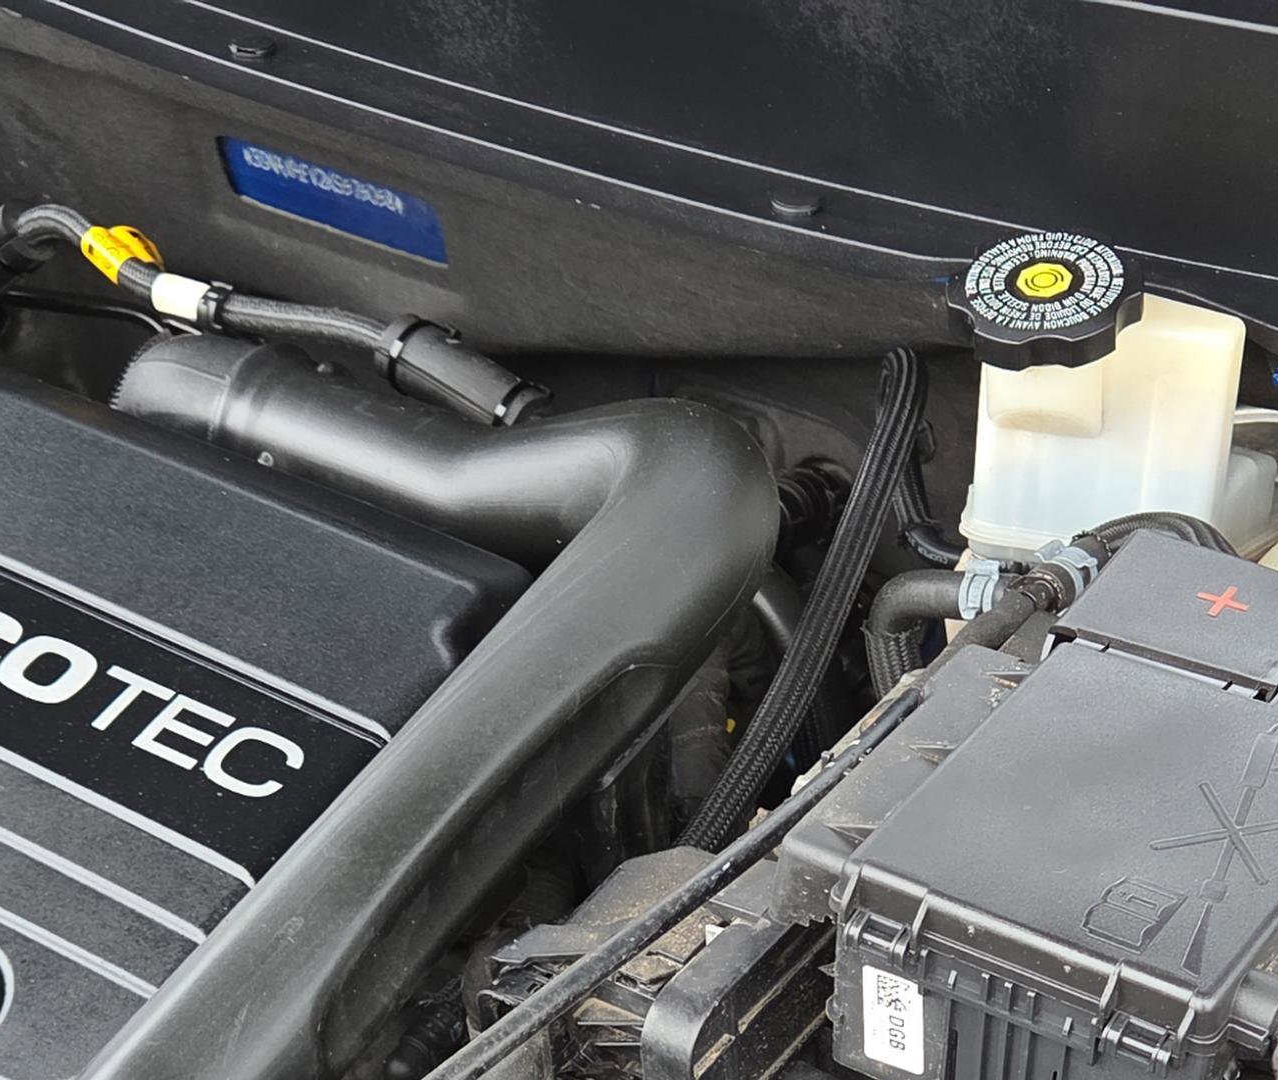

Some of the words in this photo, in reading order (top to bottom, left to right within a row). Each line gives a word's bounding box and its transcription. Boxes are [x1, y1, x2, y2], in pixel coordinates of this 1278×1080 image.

[1015, 234, 1044, 245] FROM
[1045, 232, 1073, 242] FLUID
[1035, 241, 1071, 251] BEFORE
[1030, 302, 1060, 312] BIDON
[1087, 305, 1100, 315] LE
[1028, 312, 1041, 320] DE
[1043, 311, 1088, 329] BOUCHON
[1009, 319, 1041, 329] AVANT
[885, 1007, 907, 1051] DGB
